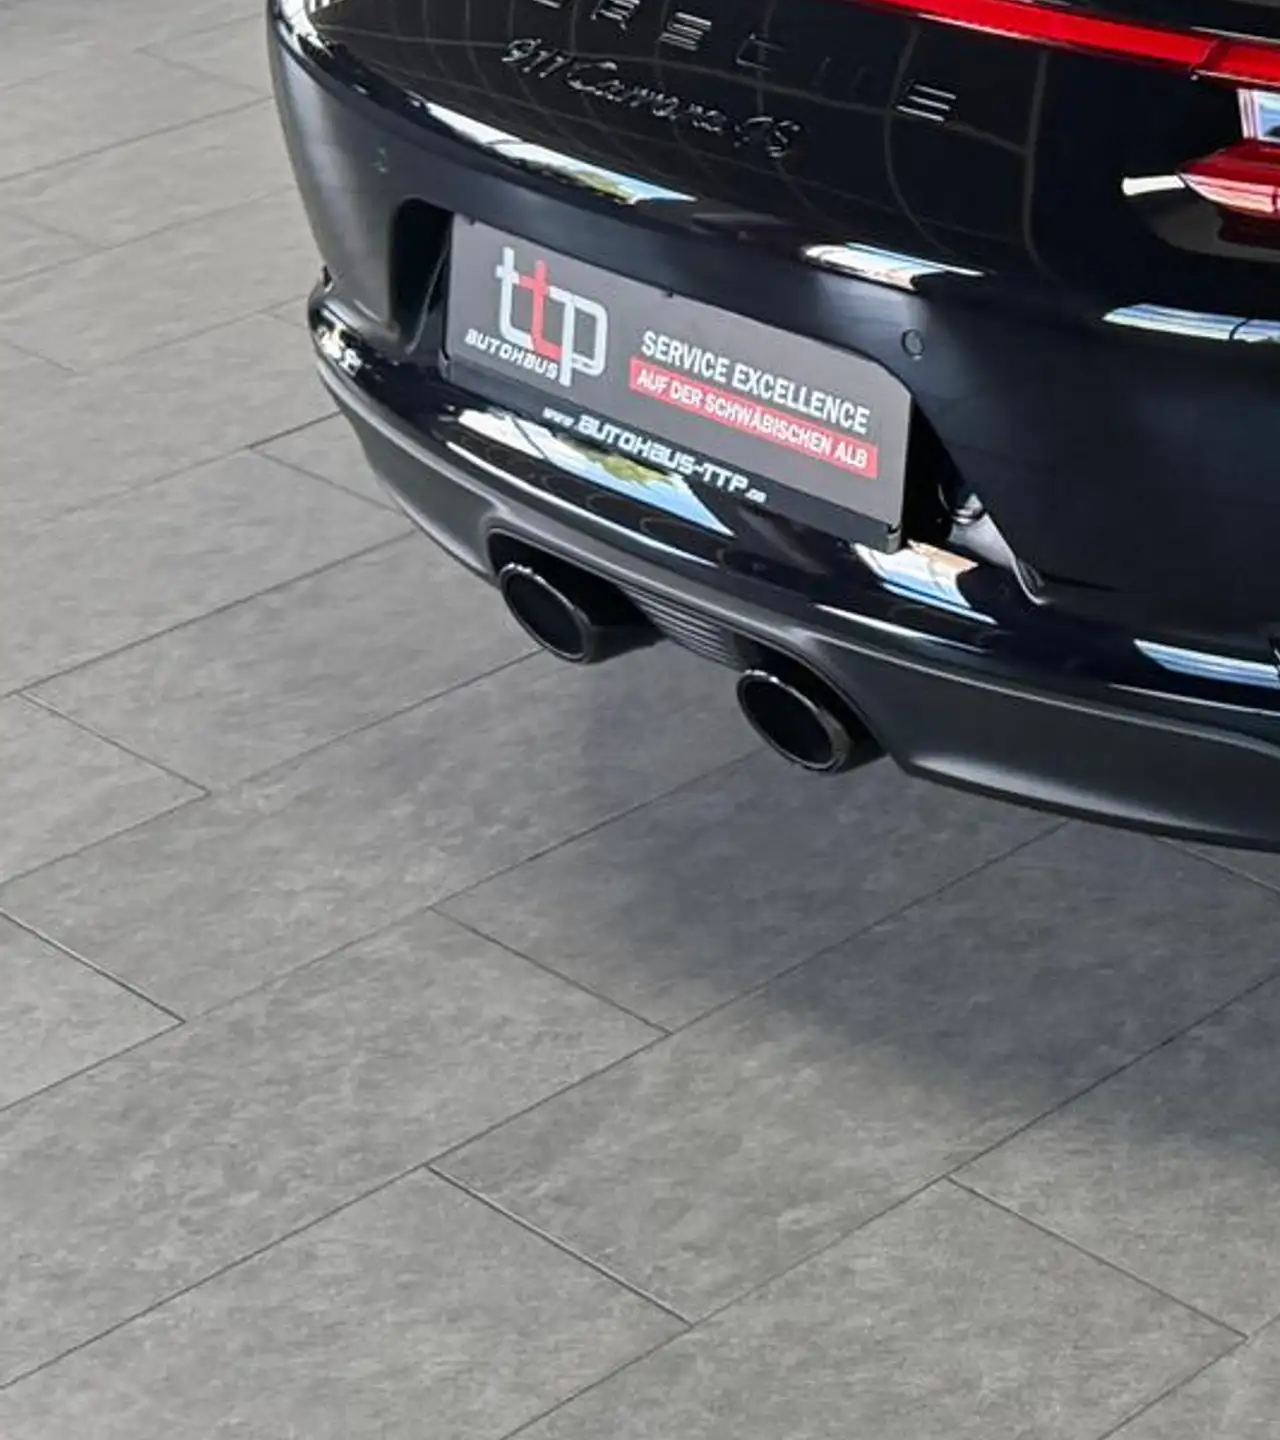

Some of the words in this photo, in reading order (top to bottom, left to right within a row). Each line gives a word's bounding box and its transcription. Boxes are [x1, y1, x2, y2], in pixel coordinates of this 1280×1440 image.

[501, 37, 564, 79] 911
[565, 60, 729, 136] Carrera
[495, 246, 608, 388] ttp
[636, 368, 669, 396] AUF
[669, 381, 704, 407] DER
[834, 443, 869, 470] ALB
[640, 329, 731, 385] SERVICE
[731, 362, 871, 436] EXCELLENCE
